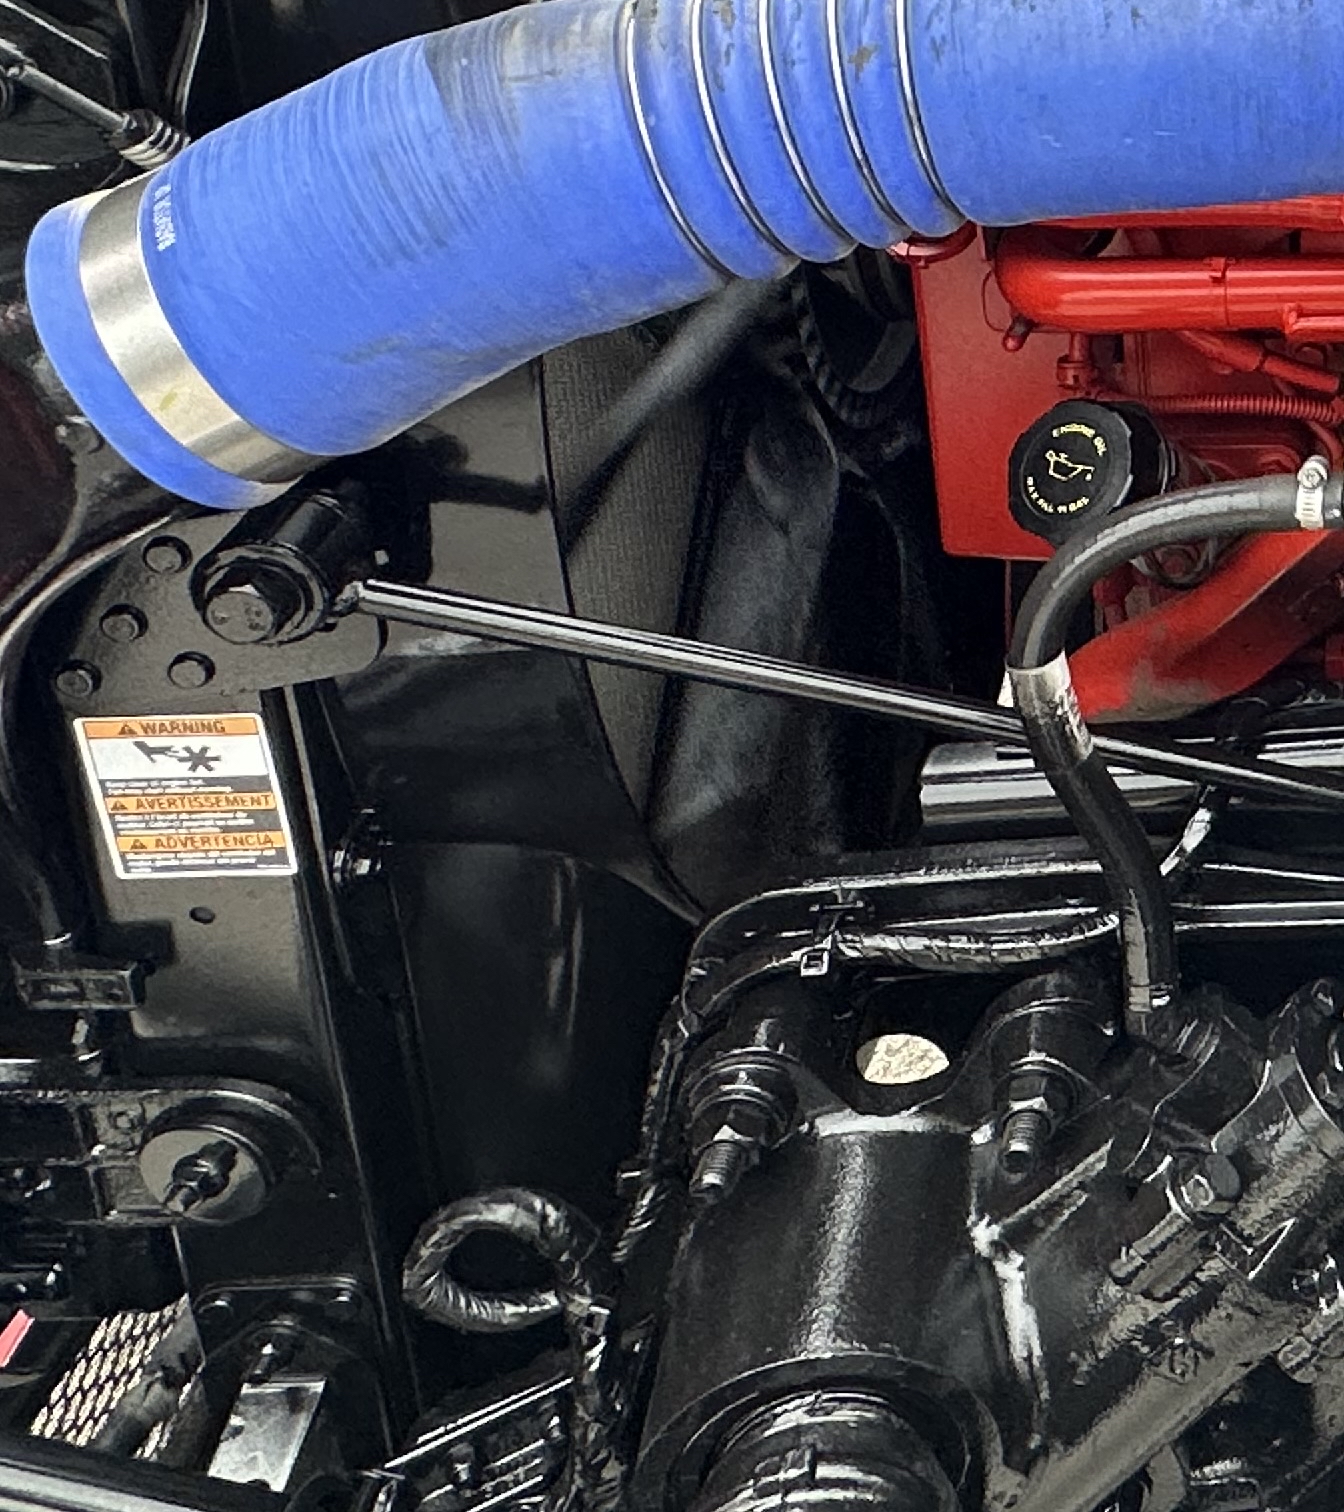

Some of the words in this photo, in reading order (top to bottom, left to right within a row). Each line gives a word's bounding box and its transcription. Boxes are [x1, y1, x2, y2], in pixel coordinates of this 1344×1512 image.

[139, 719, 226, 735] WARNING
[135, 794, 272, 811] AVERTISSEMENT
[154, 833, 275, 849] ADVERTENCIA
